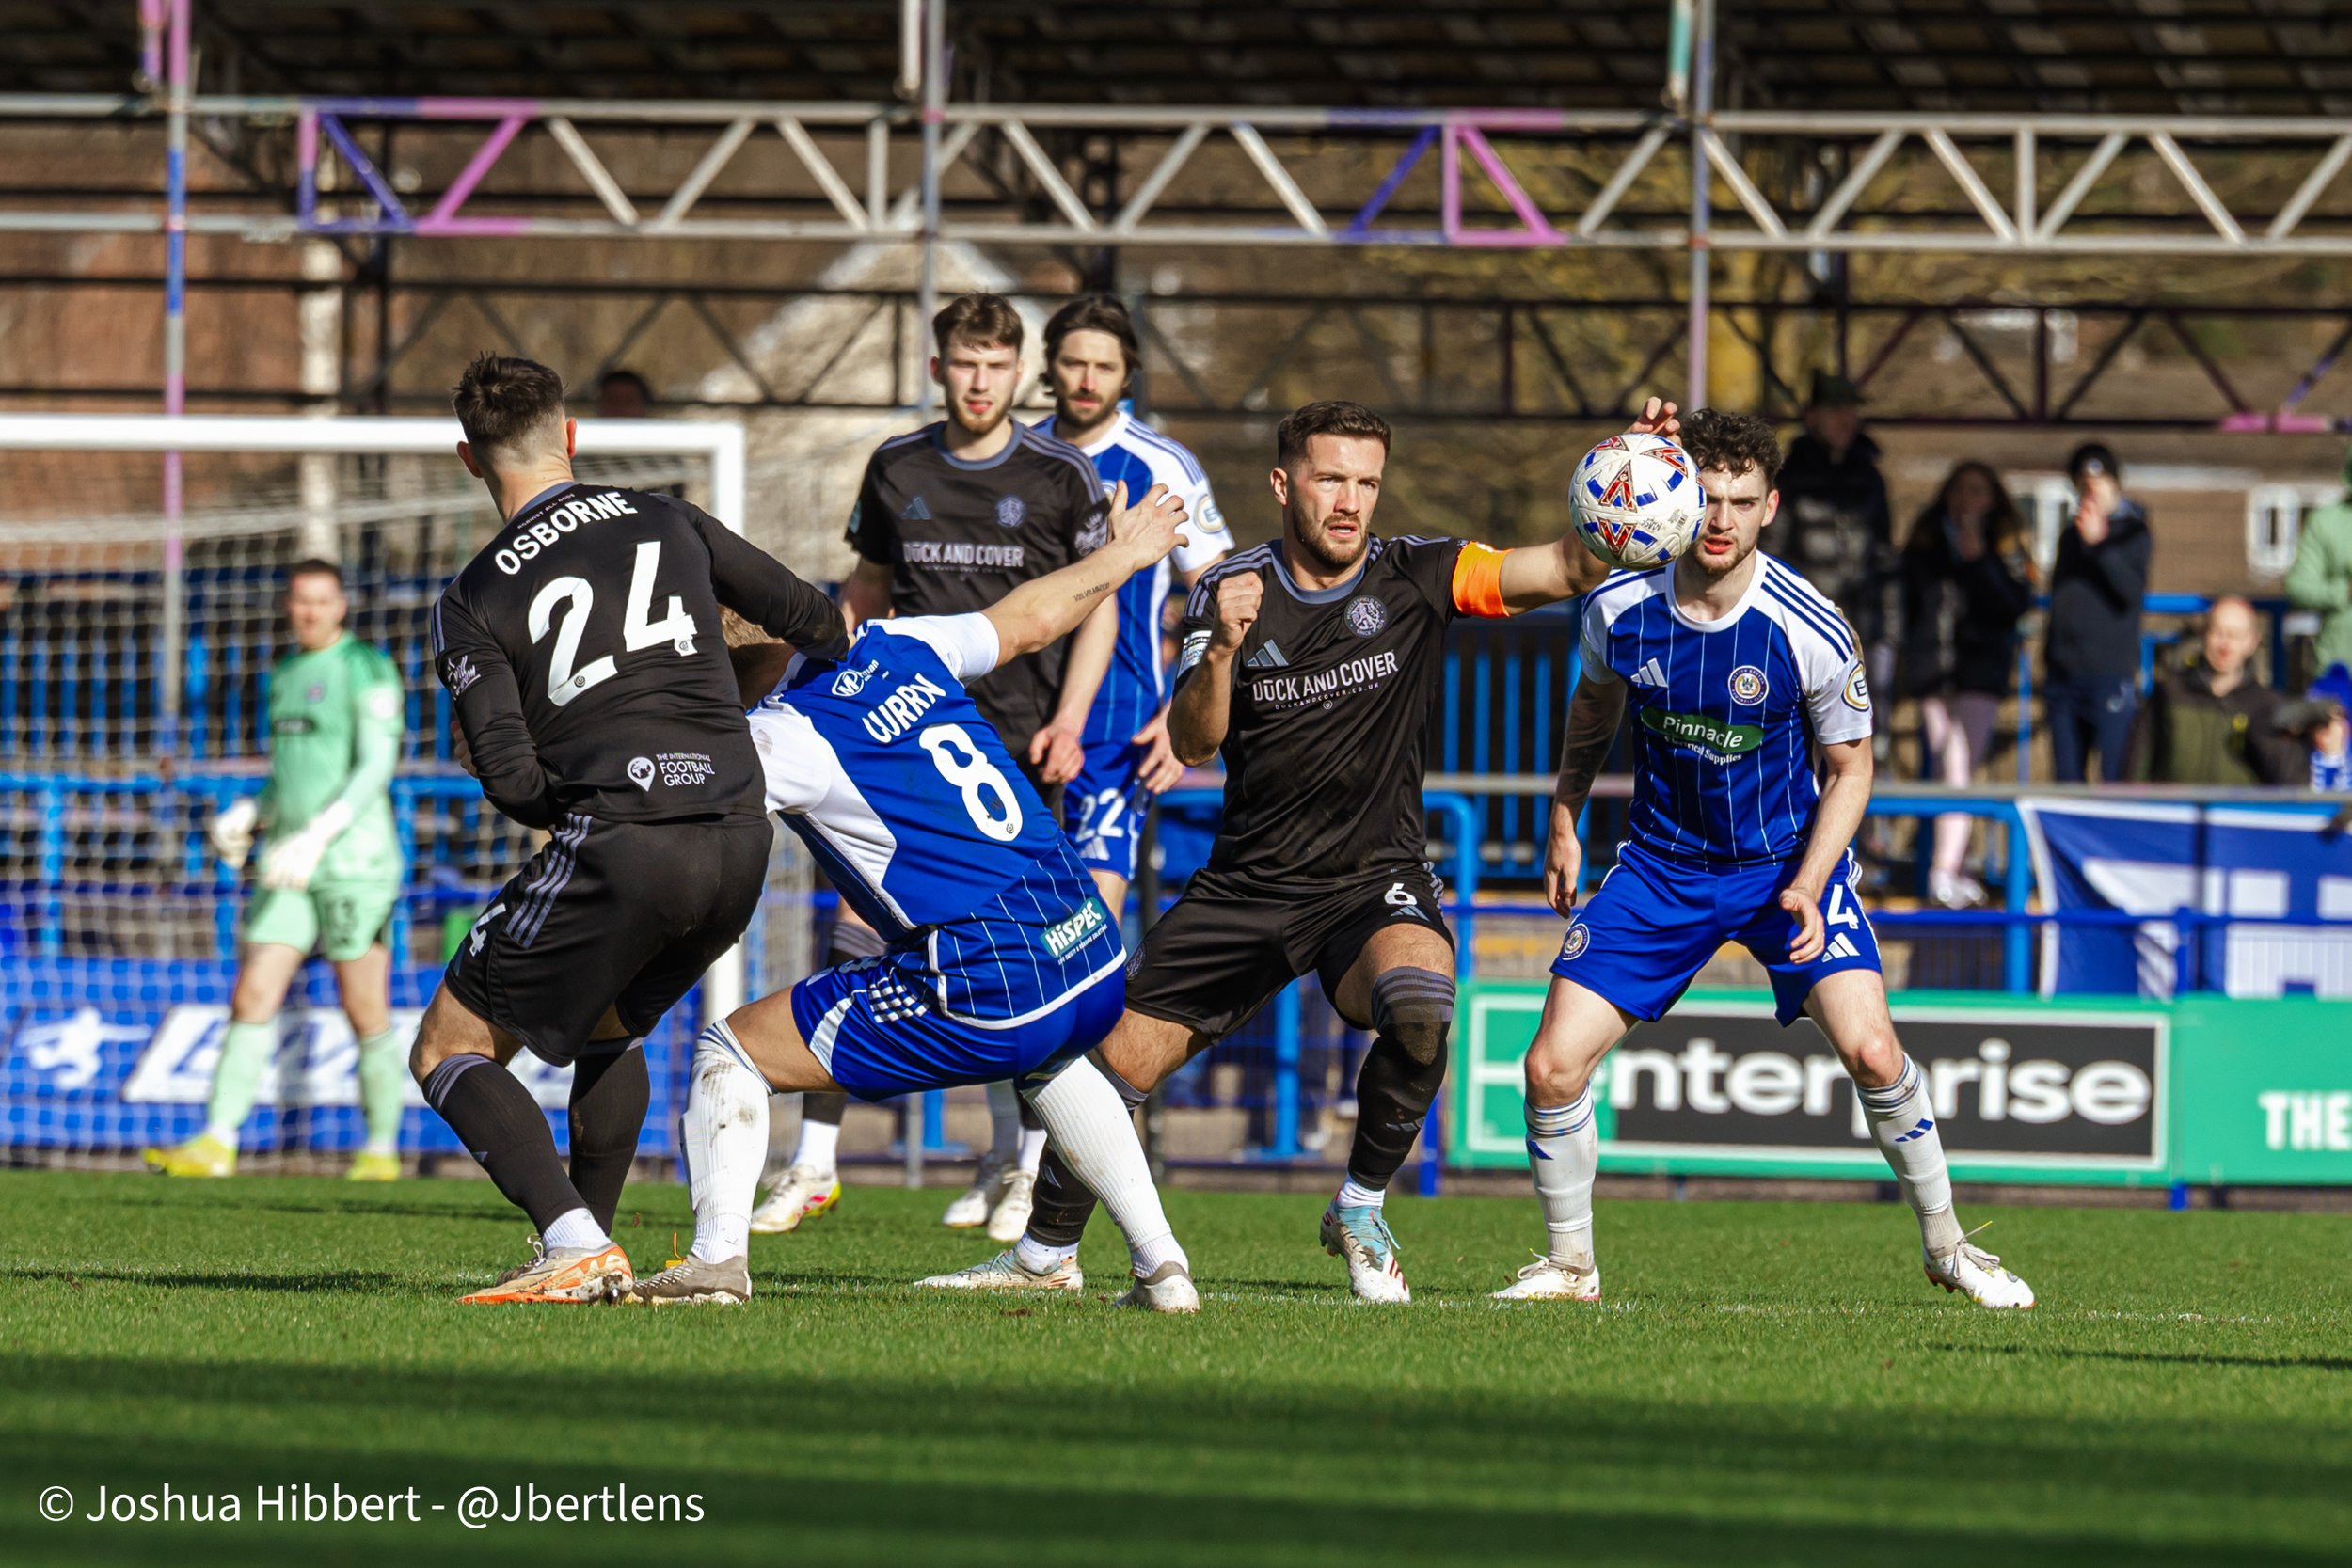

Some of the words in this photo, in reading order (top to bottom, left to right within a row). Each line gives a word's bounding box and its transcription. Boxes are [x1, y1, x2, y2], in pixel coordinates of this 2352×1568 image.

[495, 491, 638, 575] OSBORNE
[943, 543, 975, 565] AND
[975, 545, 1025, 567] COVER
[528, 541, 698, 707] 24
[1303, 669, 1338, 697] AND
[1340, 650, 1399, 687] COVER
[1663, 716, 1743, 748] Pinnacle
[660, 761, 715, 775] FOOTBALL
[663, 773, 706, 787] GROUP
[669, 752, 712, 762] INTERNATIONAL
[1704, 748, 1742, 766] Supplies
[918, 723, 1024, 842] 8
[1075, 787, 1126, 843] 22
[1384, 882, 1418, 906] 6
[1827, 884, 1860, 930] 4
[1044, 901, 1103, 958] HiSPEC
[1517, 1037, 2152, 1139] nterrise
[2258, 1091, 2352, 1149] THE
